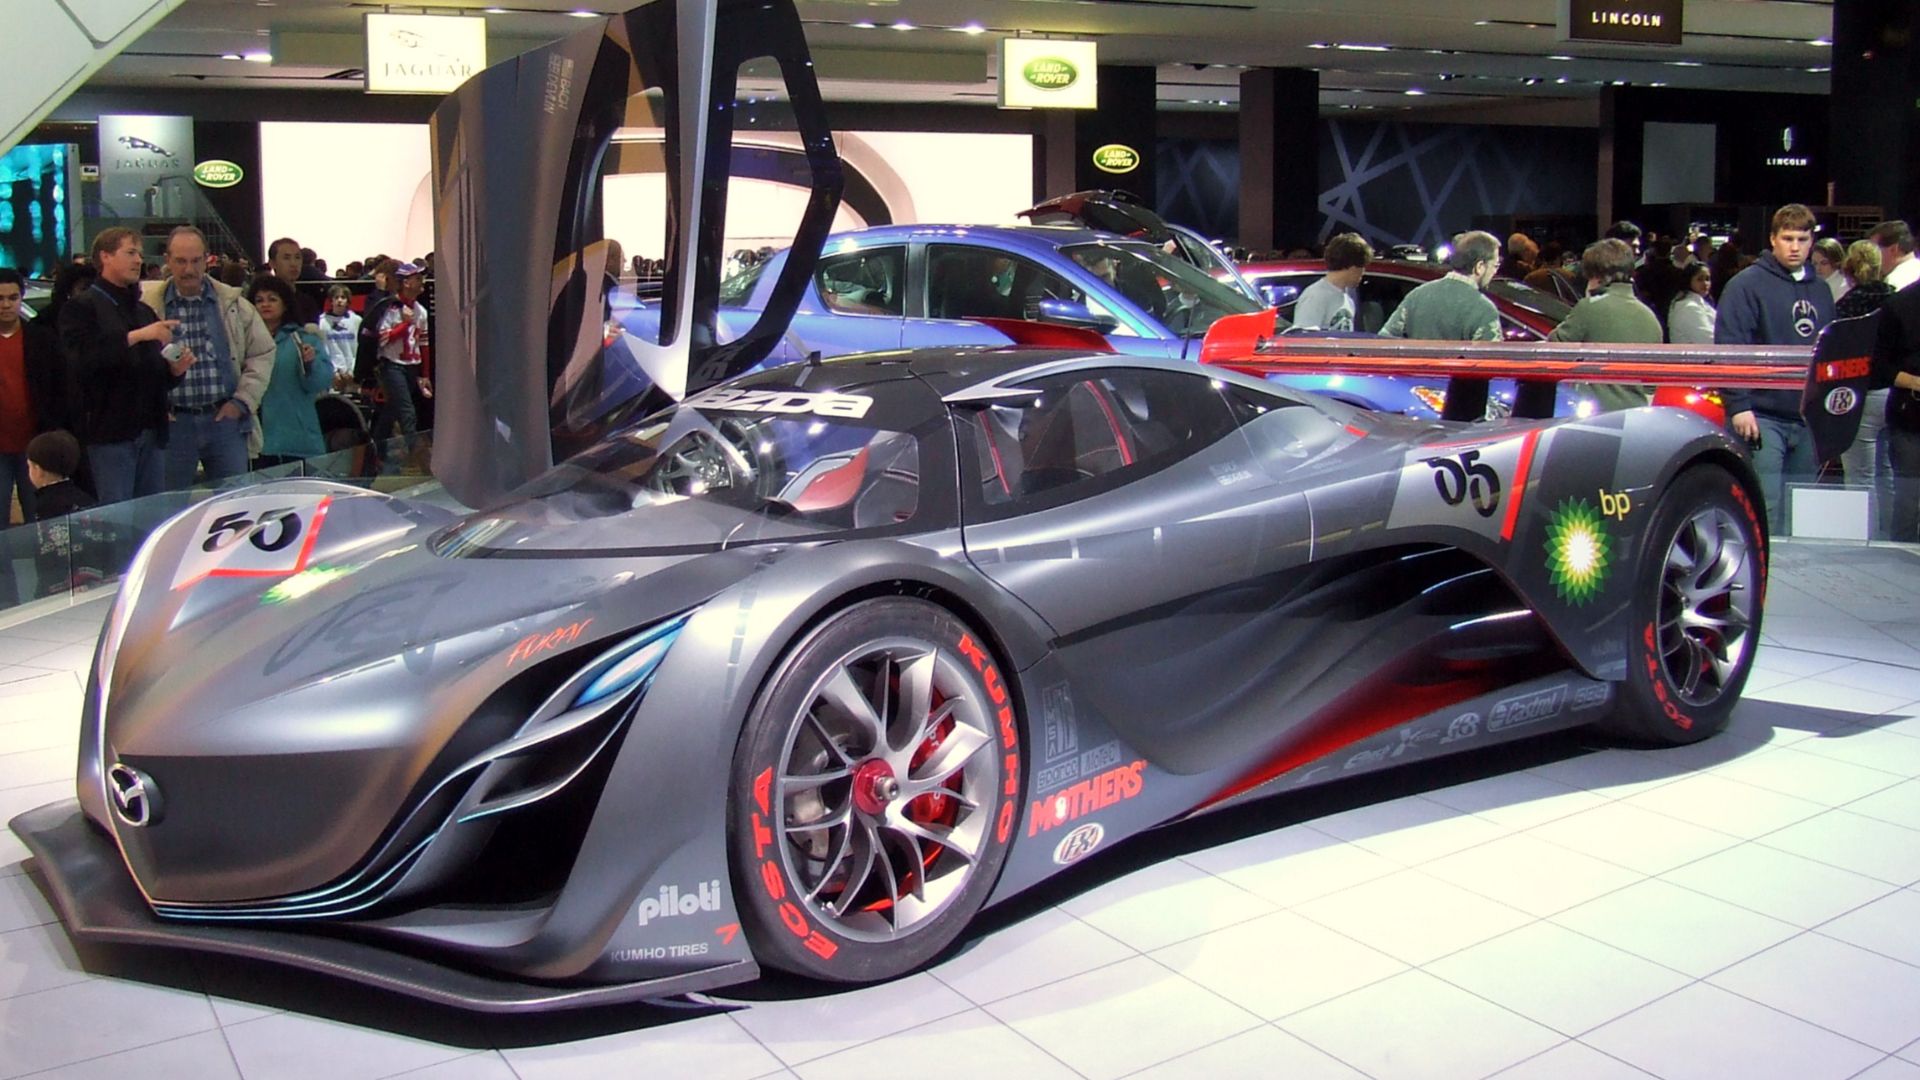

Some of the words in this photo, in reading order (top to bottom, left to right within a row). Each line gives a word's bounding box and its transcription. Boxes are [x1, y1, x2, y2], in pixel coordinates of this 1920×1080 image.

[1591, 11, 1661, 27] LINCOLN
[384, 62, 473, 77] JAGUAR
[1032, 62, 1062, 73] LAND
[1035, 73, 1071, 84] ROVER
[1103, 150, 1127, 158] LAND
[1105, 157, 1133, 166] ROVER
[115, 158, 180, 169] JAGUAR
[202, 164, 229, 173] LAND
[1766, 158, 1807, 166] LINCOLN
[205, 172, 236, 181] ROVER
[1599, 489, 1631, 521] bp
[202, 506, 303, 552] 55
[958, 633, 1018, 844] KUMHO
[1028, 760, 1145, 837] MOTHERS
[752, 766, 839, 960] ECSTA
[638, 879, 721, 926] piloti
[610, 947, 666, 963] KUMHO
[669, 943, 709, 958] TIRES
